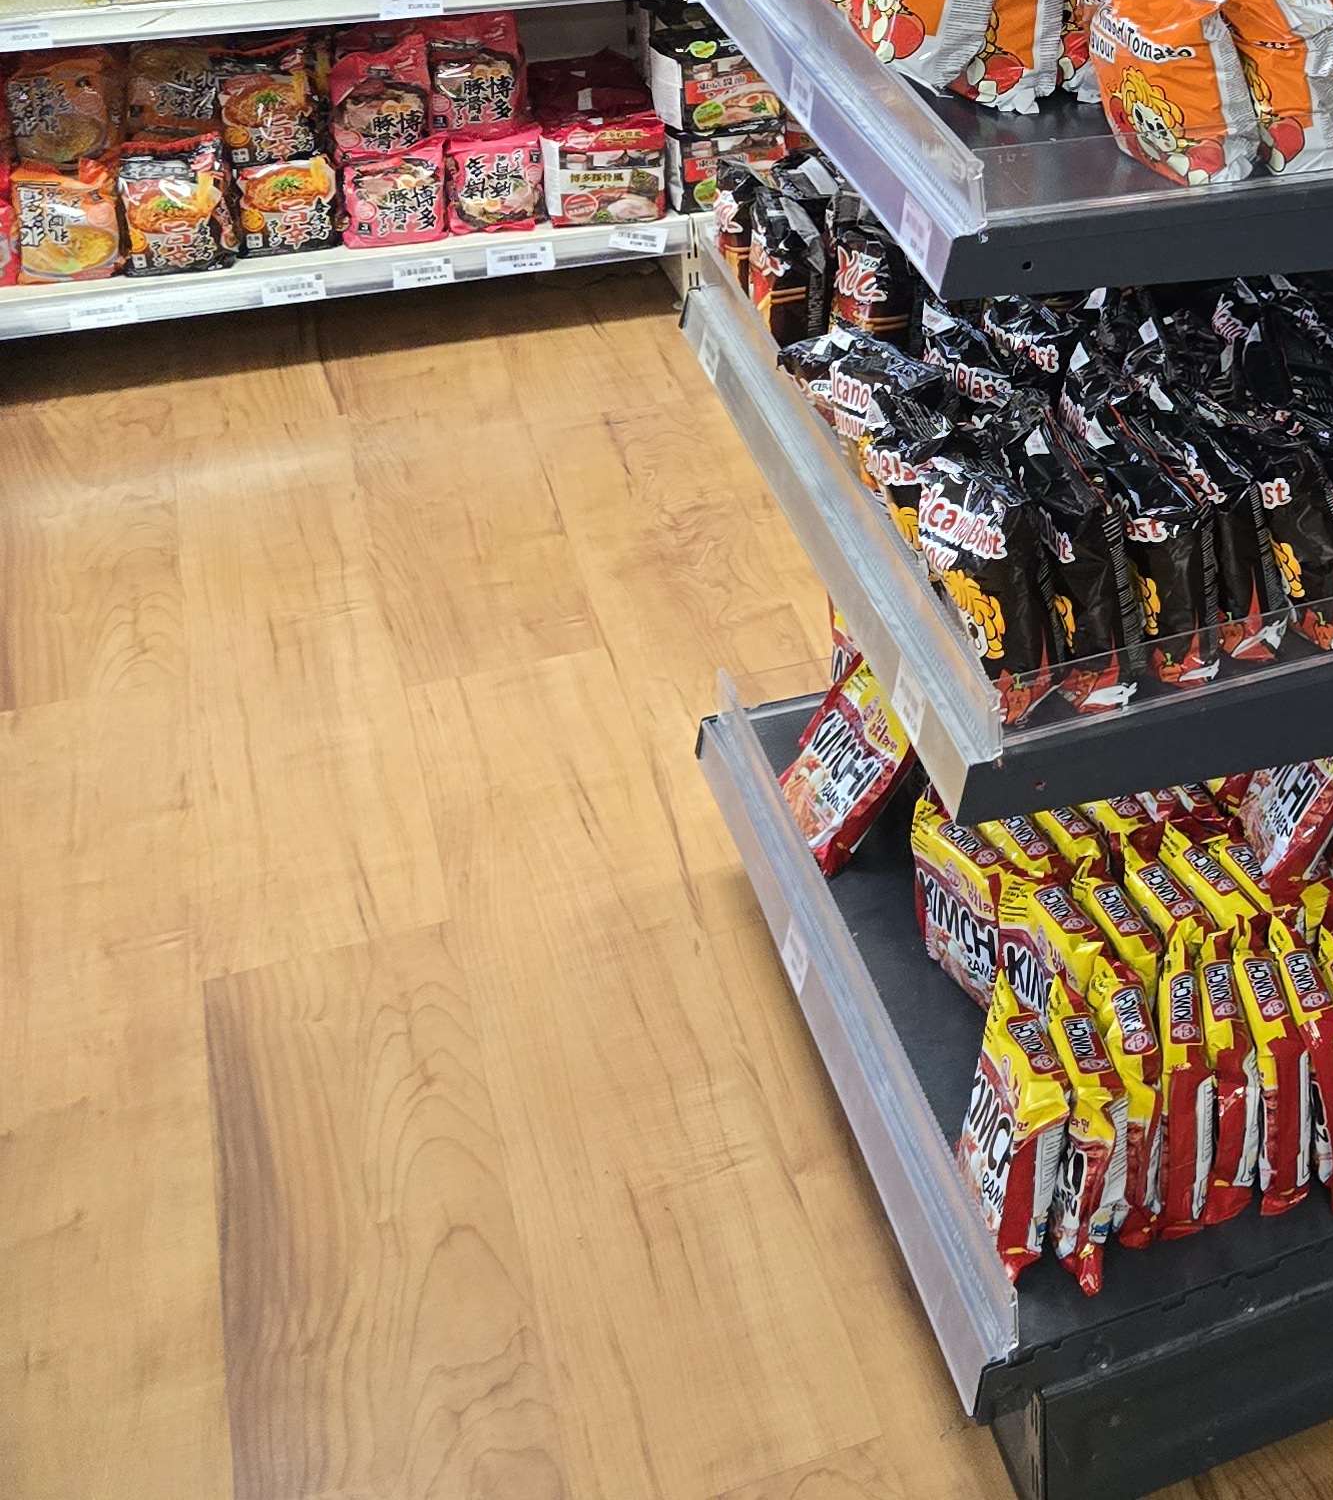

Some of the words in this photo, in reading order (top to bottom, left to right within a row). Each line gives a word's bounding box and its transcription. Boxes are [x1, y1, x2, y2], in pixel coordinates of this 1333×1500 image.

[1126, 26, 1195, 62] Tomato
[487, 76, 516, 121] 博多
[411, 183, 437, 230] 博多
[820, 780, 853, 815] RAMEN
[1209, 964, 1229, 1003] KIMCHI
[1248, 957, 1273, 1001] KIMCHI
[1285, 953, 1316, 993] KIMCHI
[1171, 976, 1196, 1022] KIMCHI
